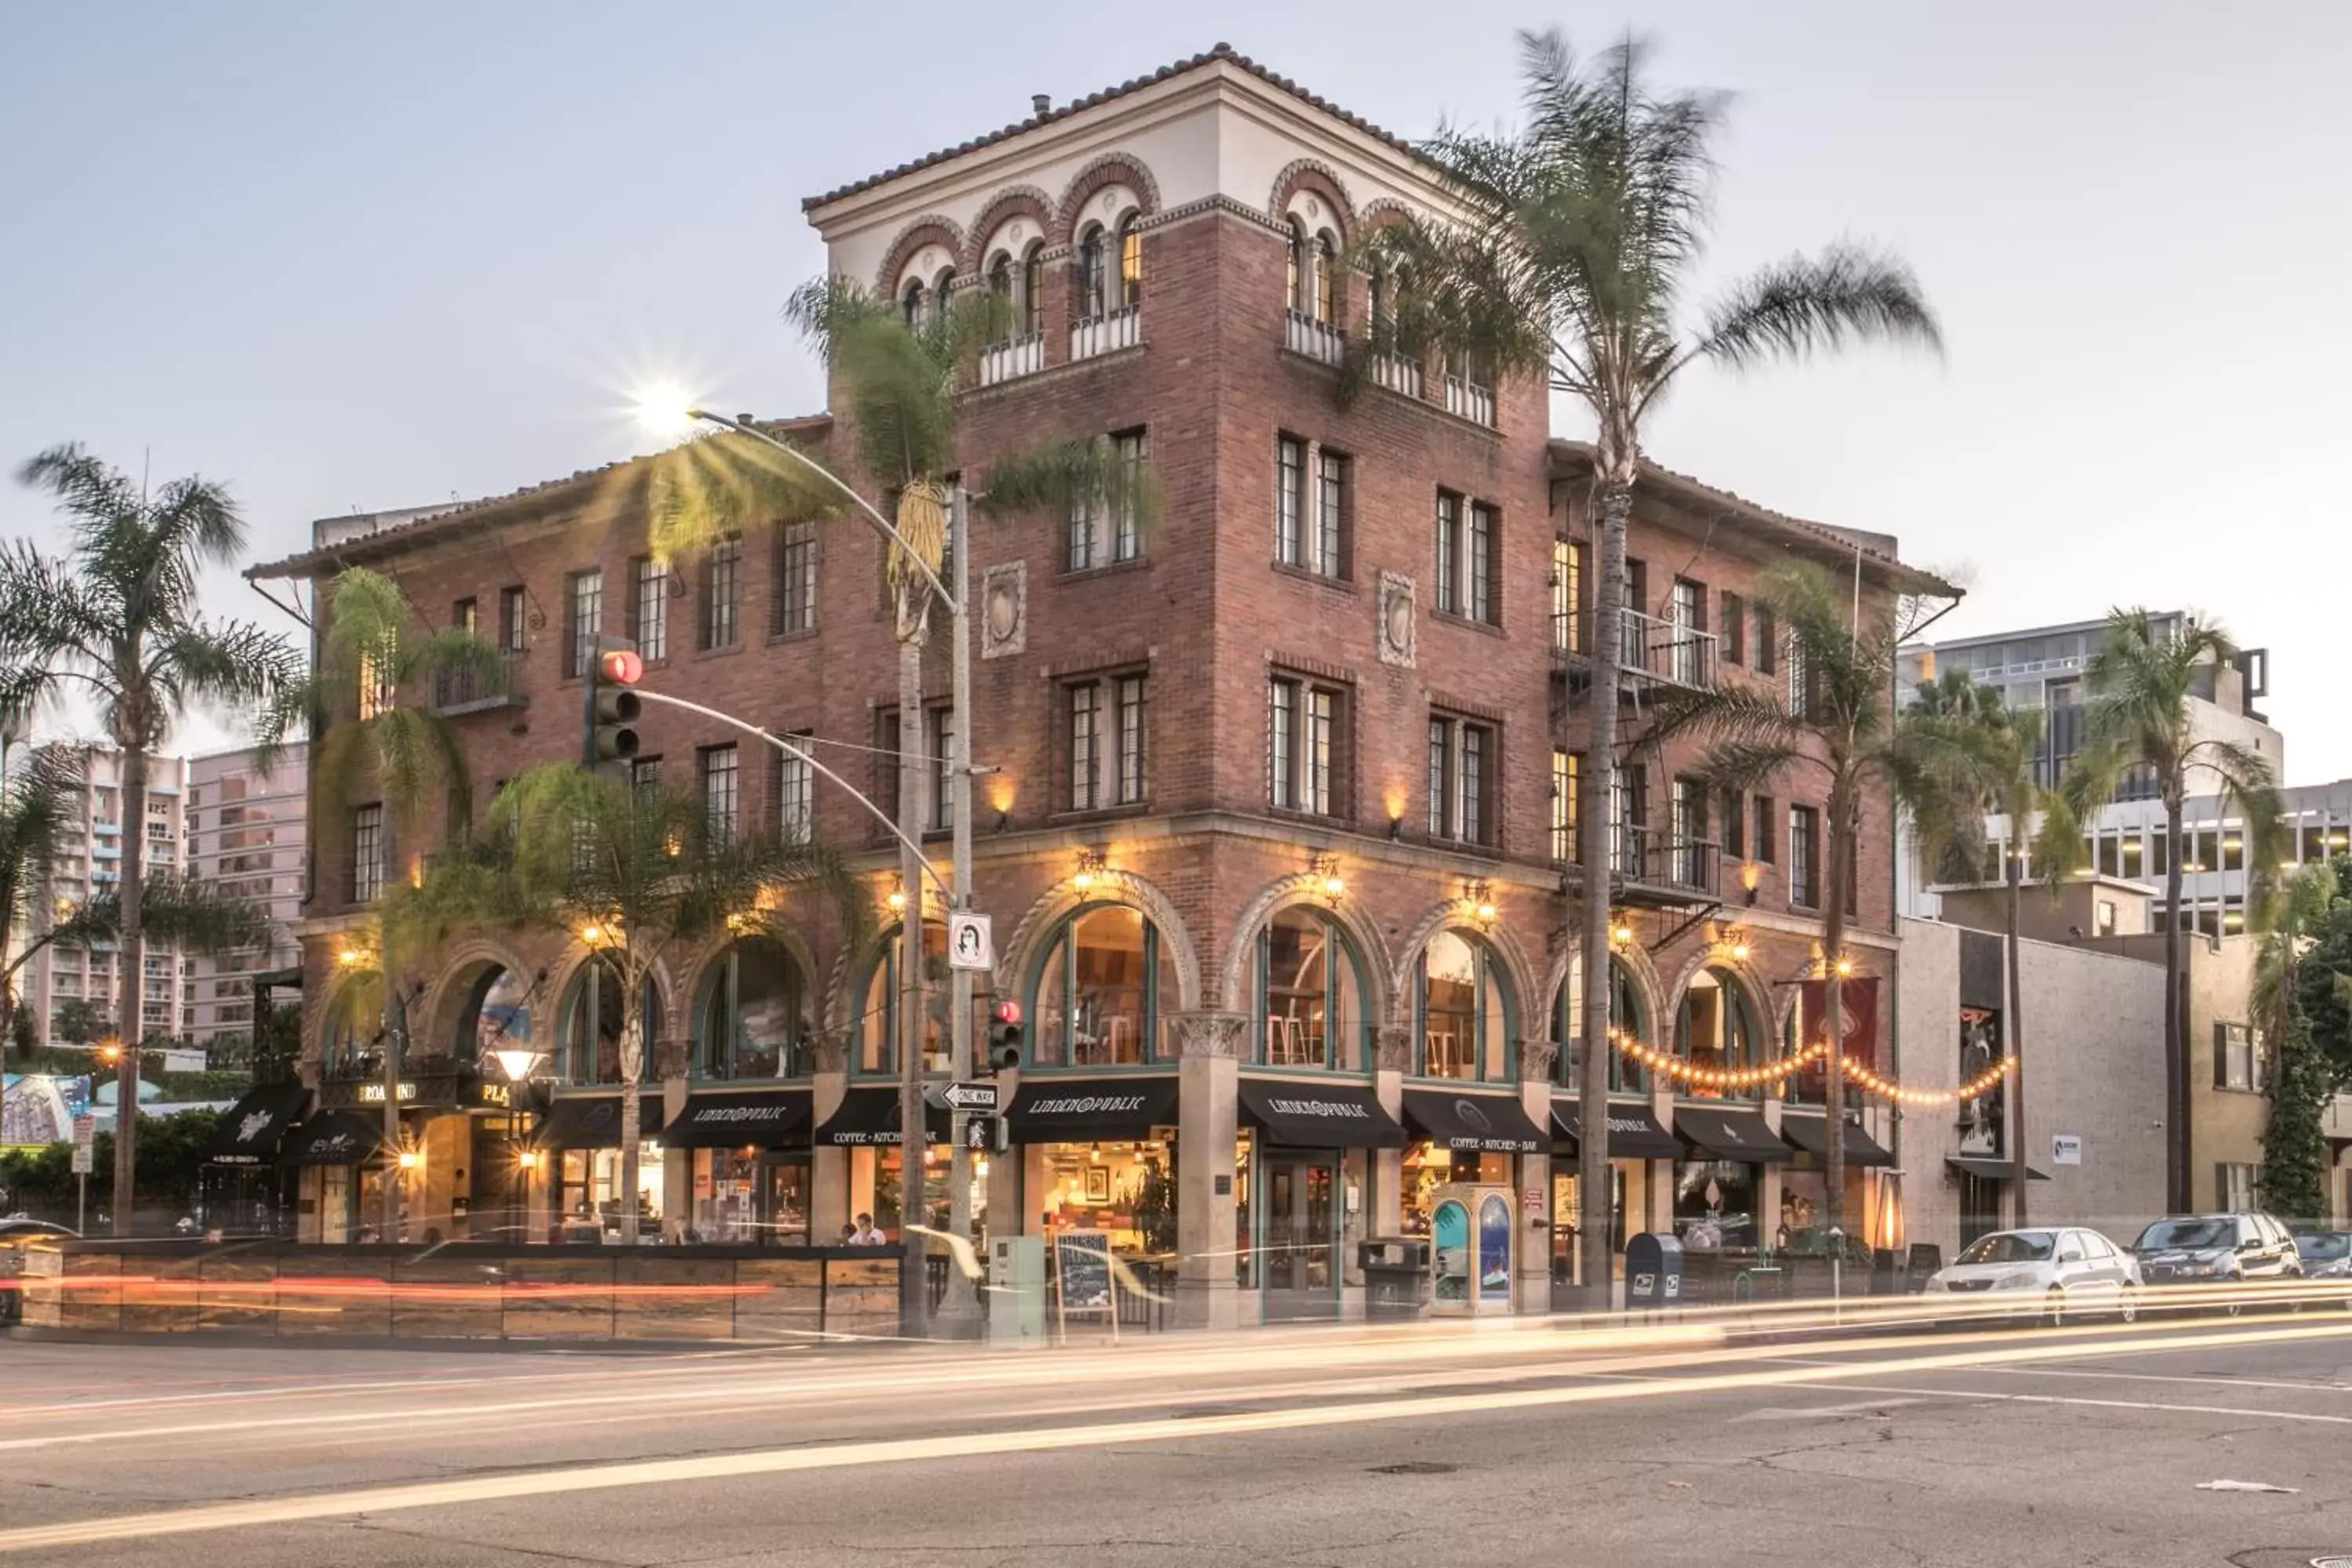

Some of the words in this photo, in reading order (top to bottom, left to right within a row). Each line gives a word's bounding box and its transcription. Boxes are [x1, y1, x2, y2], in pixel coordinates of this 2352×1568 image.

[358, 1083, 416, 1102] BROAIND
[959, 1091, 974, 1102] ONE
[975, 1092, 993, 1102] WAY
[833, 1132, 866, 1142] COFFEE
[926, 1131, 937, 1142] AR
[1450, 1137, 1479, 1148] COFFEE
[1485, 1139, 1517, 1150] KITCHEN
